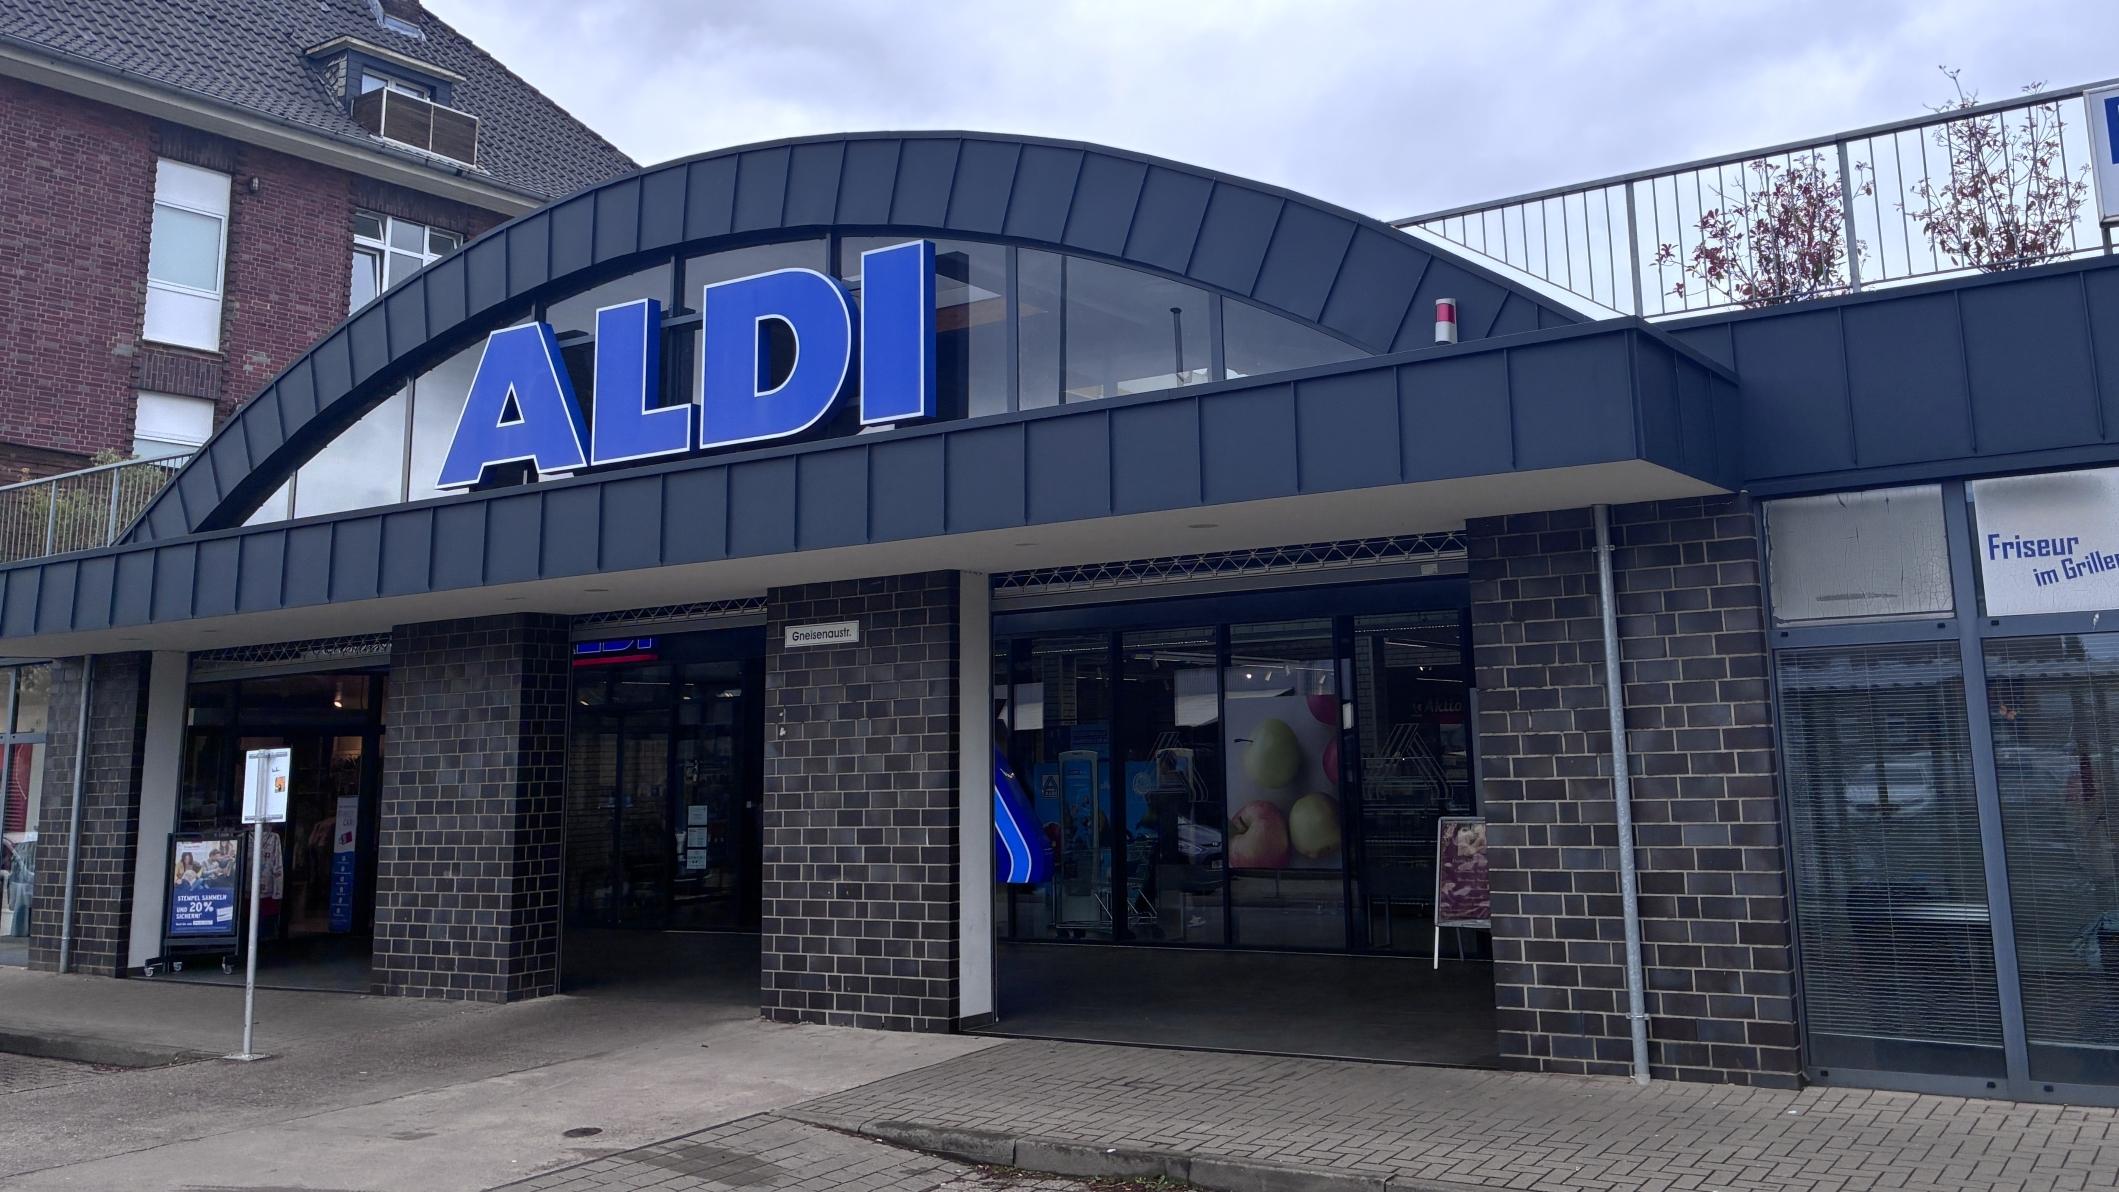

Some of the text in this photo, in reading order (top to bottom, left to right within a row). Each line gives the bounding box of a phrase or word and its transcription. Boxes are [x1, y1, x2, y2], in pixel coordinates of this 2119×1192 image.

[434, 239, 936, 489] ALDI
[1987, 533, 2079, 560] Friseur
[2033, 568, 2060, 587] im
[792, 627, 852, 641] Gneisenaustr.
